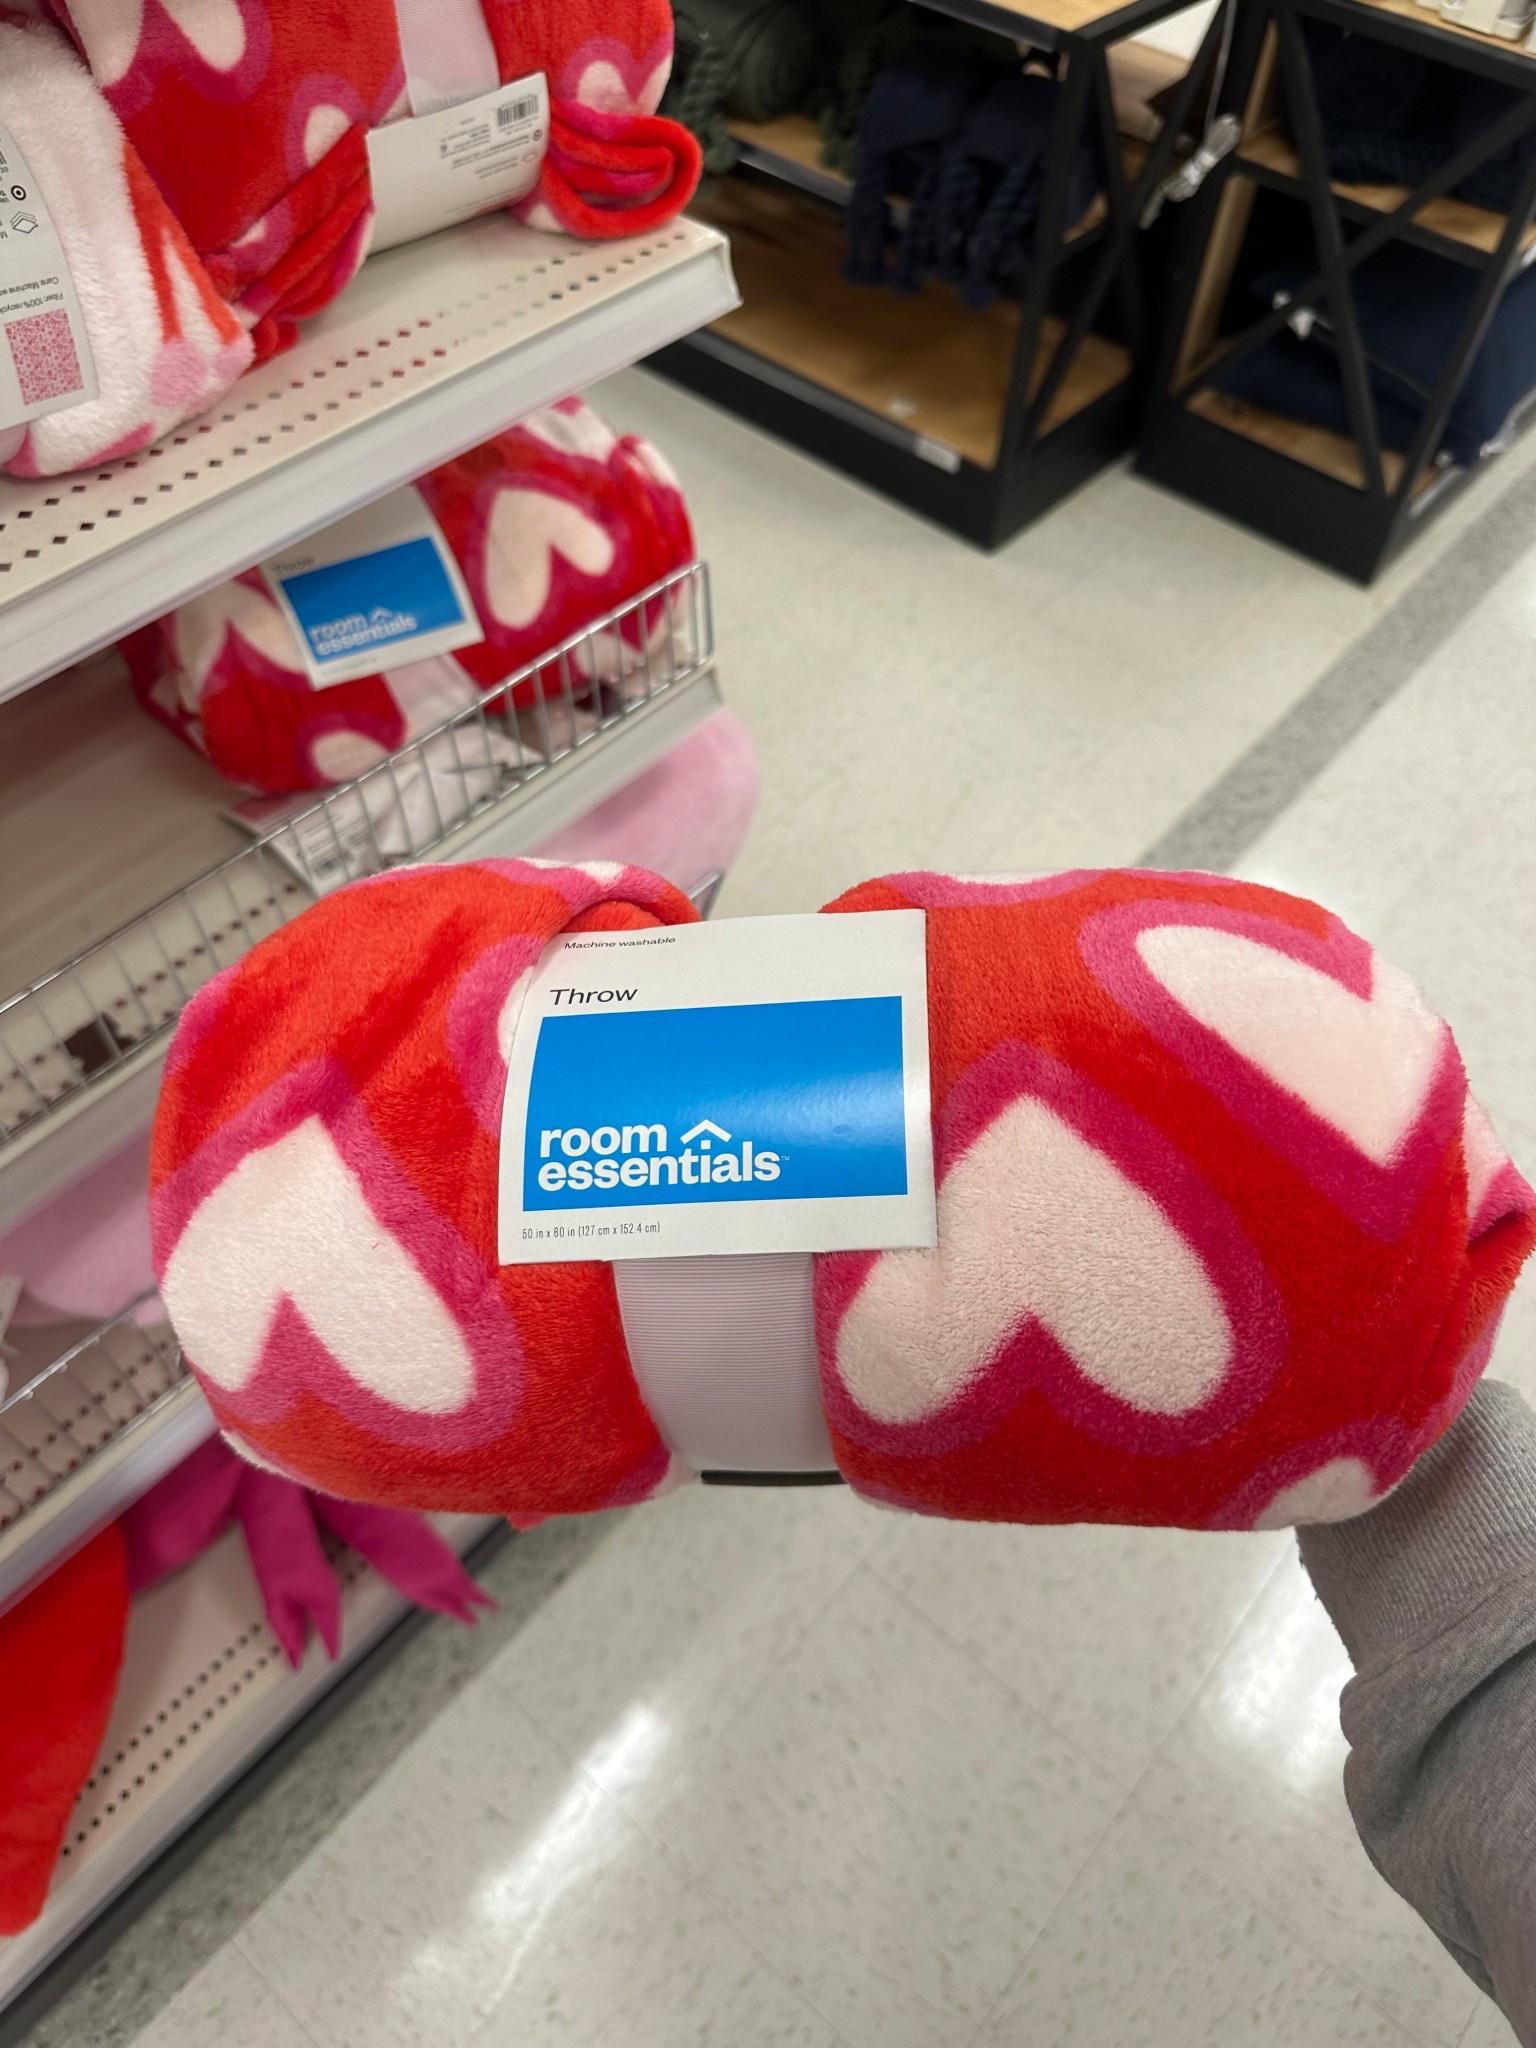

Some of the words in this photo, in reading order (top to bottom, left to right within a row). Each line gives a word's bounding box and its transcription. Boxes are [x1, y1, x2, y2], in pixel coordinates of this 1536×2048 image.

[9, 282, 40, 293] Machine
[23, 298, 44, 309] 100%
[310, 612, 369, 642] room
[564, 941, 617, 950] Machine
[619, 937, 677, 947] washable
[549, 988, 639, 1006] Throw
[540, 1123, 668, 1158] room
[538, 1140, 782, 1192] essentials
[522, 1228, 533, 1239] 50
[535, 1229, 544, 1239] in
[567, 1227, 576, 1237] in
[578, 1225, 596, 1238] (127
[598, 1226, 610, 1236] cm
[620, 1222, 642, 1235] 152.4
[645, 1221, 661, 1234] cm)
